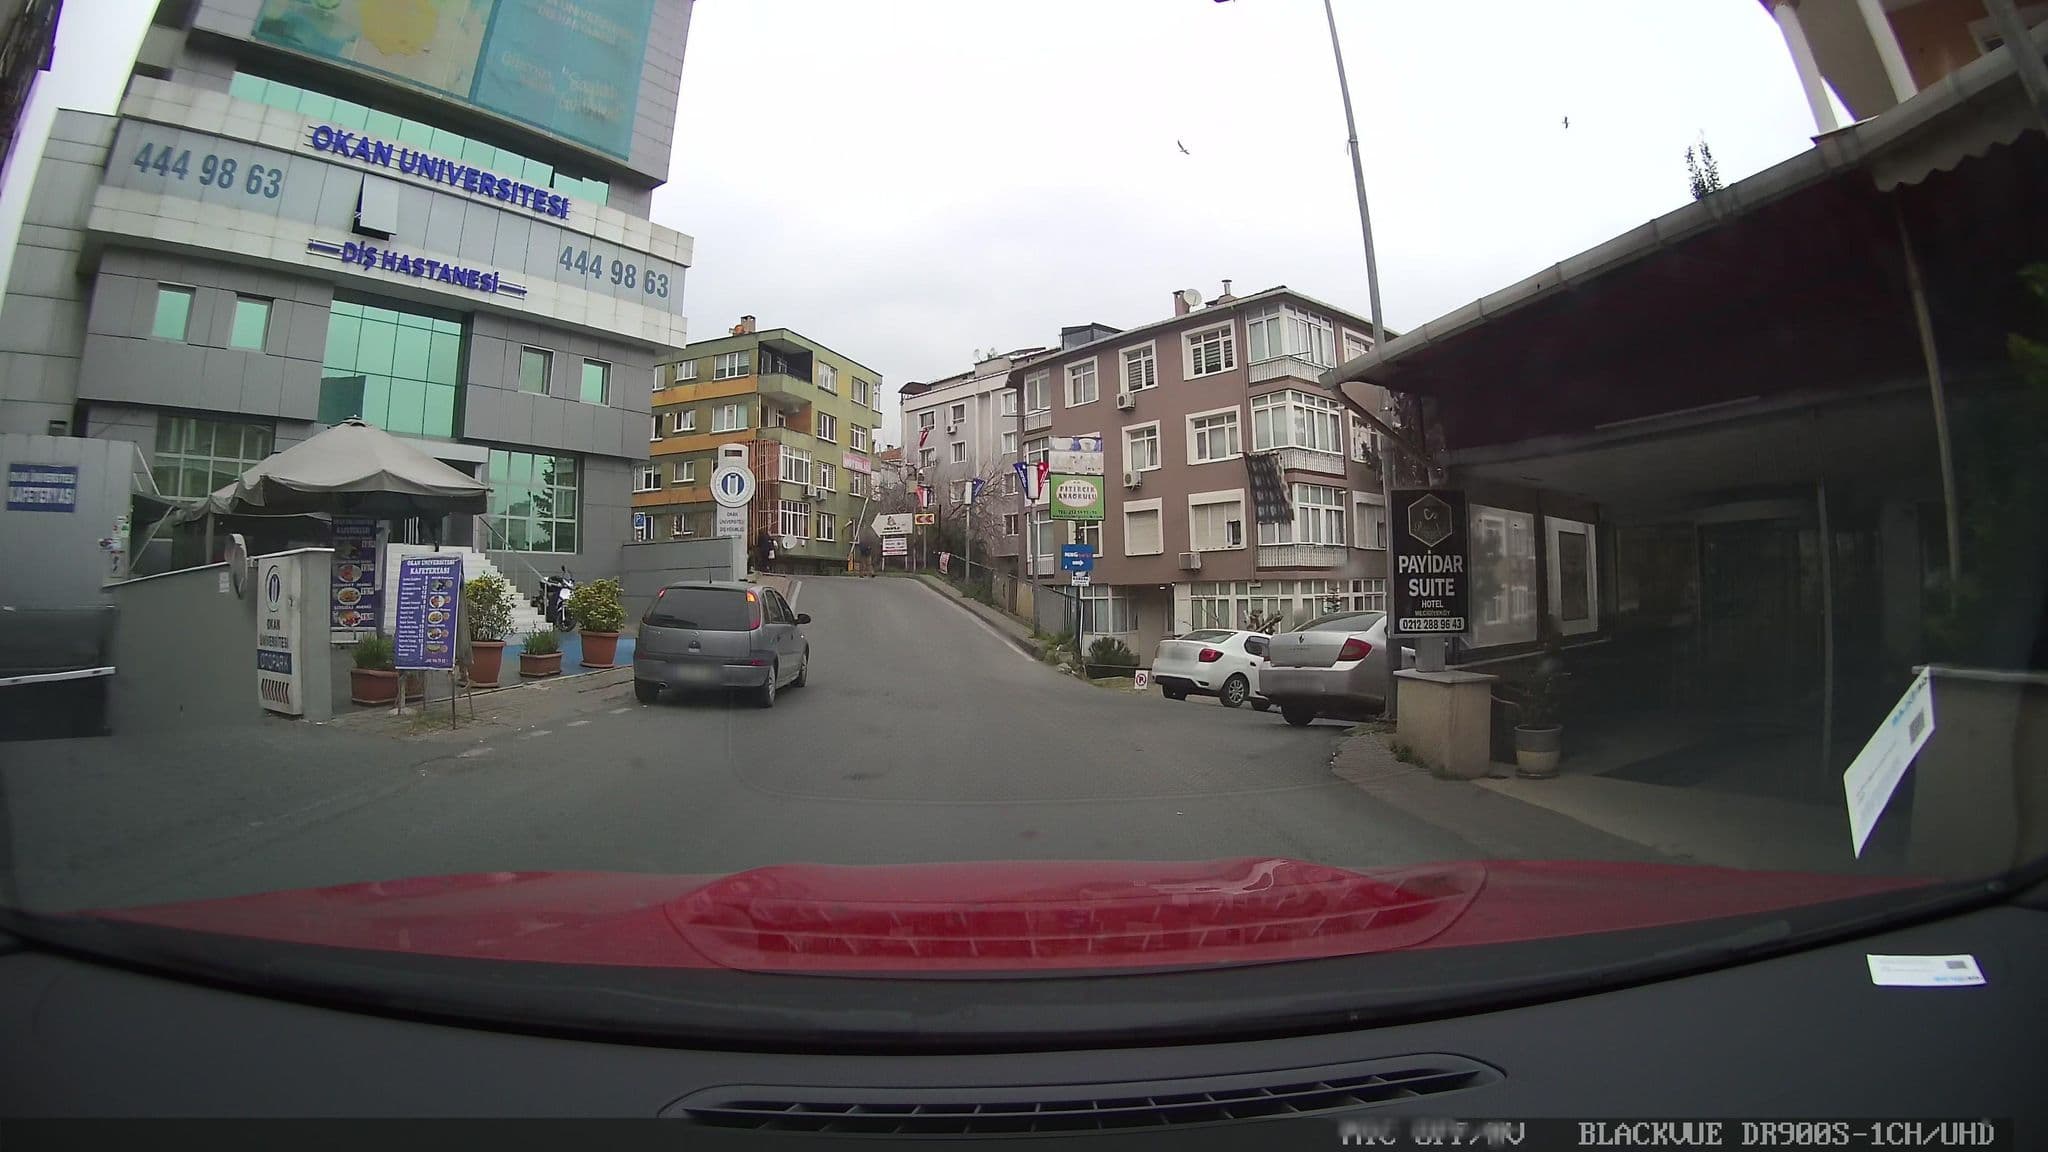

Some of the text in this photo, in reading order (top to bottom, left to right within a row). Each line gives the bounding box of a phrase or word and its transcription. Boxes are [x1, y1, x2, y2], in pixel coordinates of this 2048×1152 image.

[312, 125, 394, 168] OKAN
[134, 142, 283, 199] 444 98 63
[342, 240, 500, 294] DİŞ HASTANESİ
[559, 245, 669, 299] 444 98 63
[1398, 550, 1463, 574] PAYİDAR
[1408, 578, 1456, 597] SUITE
[1421, 599, 1444, 609] HOTEL
[266, 618, 281, 631] OKAN
[1402, 620, 1462, 630] 0212 288 96 43
